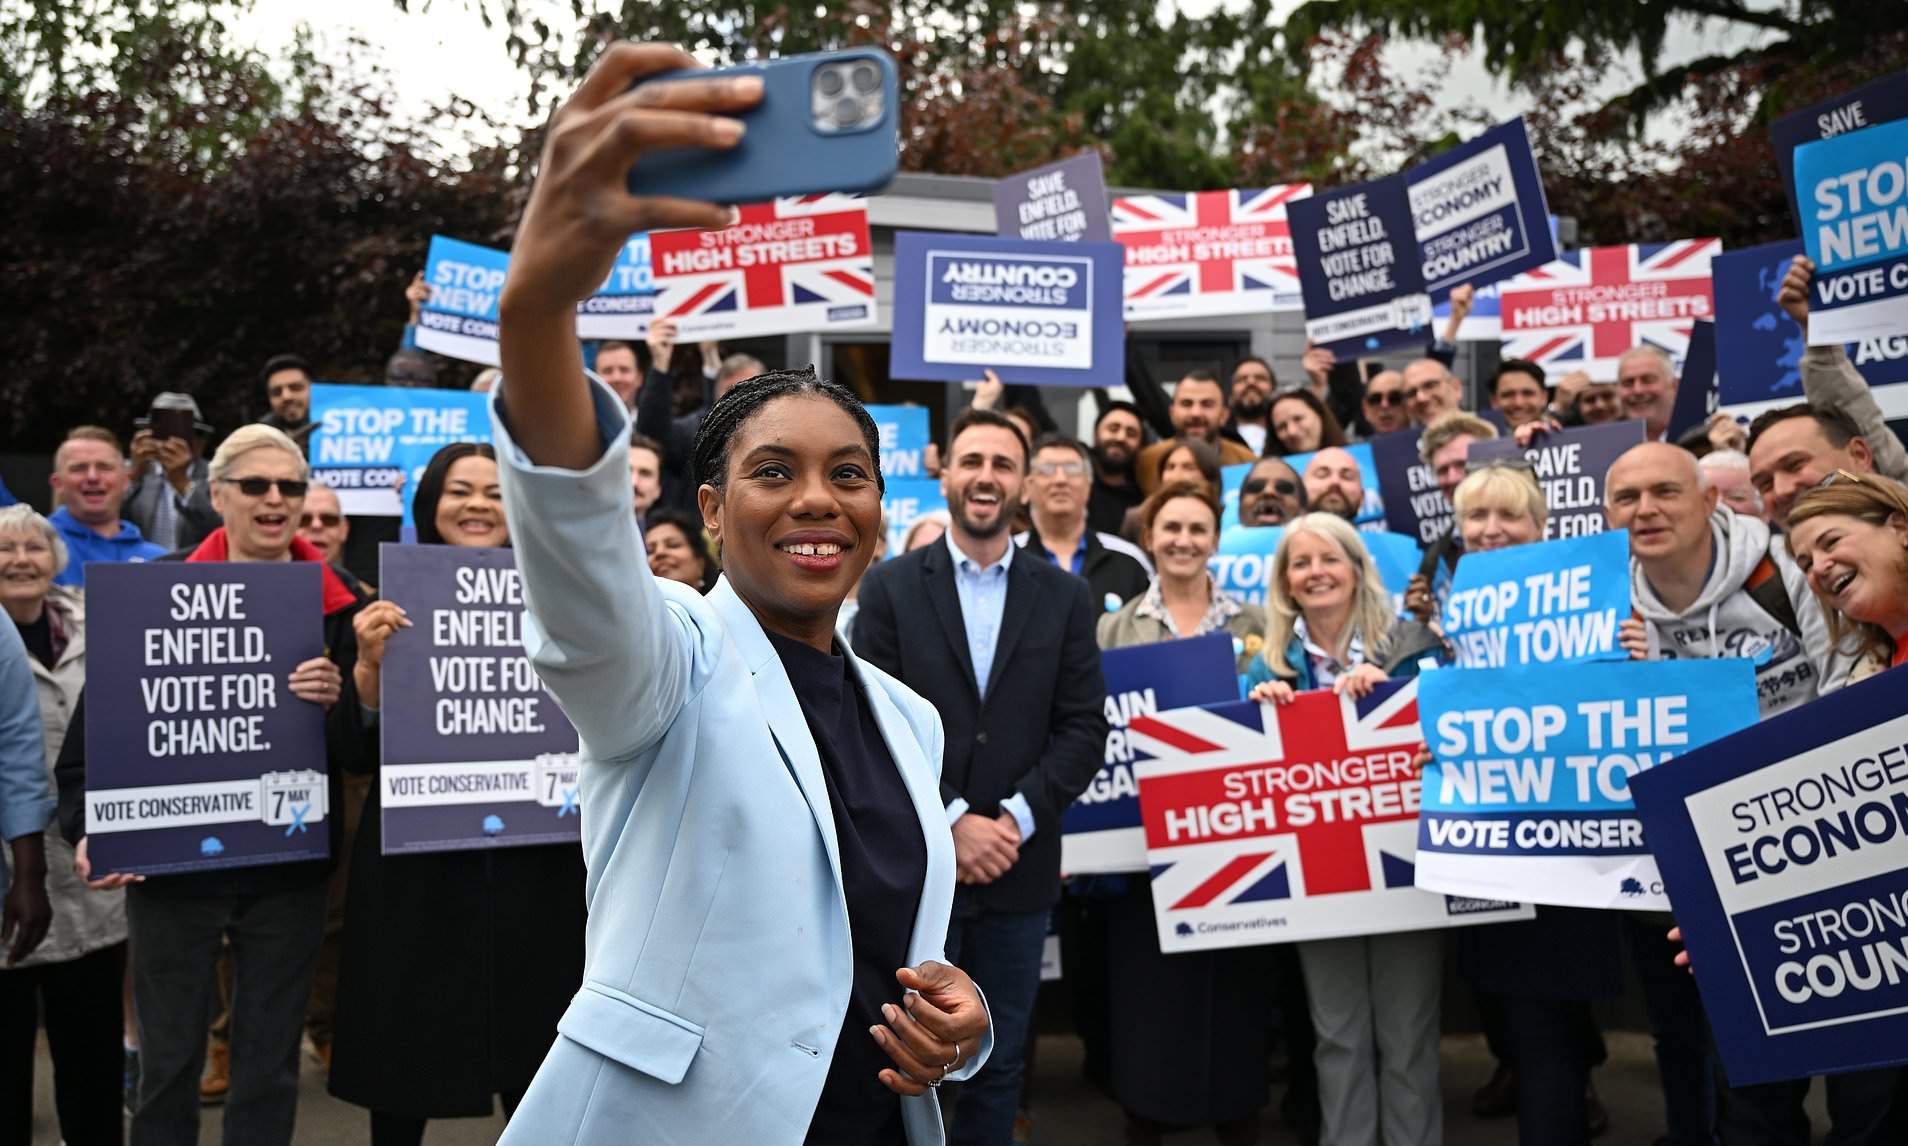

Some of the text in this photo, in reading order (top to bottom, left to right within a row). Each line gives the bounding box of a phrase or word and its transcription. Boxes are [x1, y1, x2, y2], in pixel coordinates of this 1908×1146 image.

[1818, 101, 1867, 139] SAVE
[1027, 170, 1066, 200] SAVE
[1414, 175, 1502, 229] CONOMY
[1814, 158, 1908, 222] STO
[1056, 209, 1088, 236] FOR
[1325, 192, 1369, 225] SAVE
[699, 217, 815, 249] STRONGER
[1160, 223, 1266, 245] STRONGER
[1317, 216, 1388, 252] ENFIELD.
[663, 247, 733, 275] HIGH
[737, 233, 858, 266] STREETS
[1125, 246, 1190, 266] HIGH
[1320, 242, 1395, 280] VOTE FOR
[1421, 226, 1513, 281] COUNTRY
[942, 262, 1077, 288] COUNTRY
[1327, 268, 1397, 302] CHANGE.
[1817, 268, 1885, 305] VOTE
[429, 284, 496, 315] NEW
[951, 284, 1068, 304] STRONGER
[1513, 294, 1710, 327] HIGH STREETS
[1551, 282, 1667, 306] STRONGER
[940, 317, 1078, 339] ECONOMY
[321, 408, 468, 436] STOP THE
[319, 435, 395, 463] NEW
[170, 583, 246, 621] SAVE
[456, 567, 521, 604] SAVE
[1447, 581, 1519, 634] STOP
[1525, 565, 1591, 617] THE
[433, 609, 526, 647] ENFIEL
[1450, 608, 1616, 669] NEW TOWN
[145, 627, 271, 666] ENFIELD.
[430, 657, 496, 692] VOTE
[141, 673, 277, 714] VOTE FOR
[436, 698, 546, 734] CHANGE.
[1436, 695, 1689, 757] STOP THE
[148, 716, 271, 757] CHANGE.
[390, 772, 529, 796] VOTE CONSERVATIVE
[547, 773, 556, 799] 7
[1223, 751, 1413, 799] STRONGER
[1439, 752, 1687, 804] NEW TO
[1732, 740, 1908, 834] STRONGE
[94, 791, 253, 821] VOTE CONSERVATIVE
[272, 790, 311, 819] 7 MAY
[1165, 780, 1421, 841] HIGH STREE
[1427, 819, 1644, 849] VOTE CONSER
[1196, 917, 1288, 935] Conservatives
[1774, 888, 1908, 954] STRON
